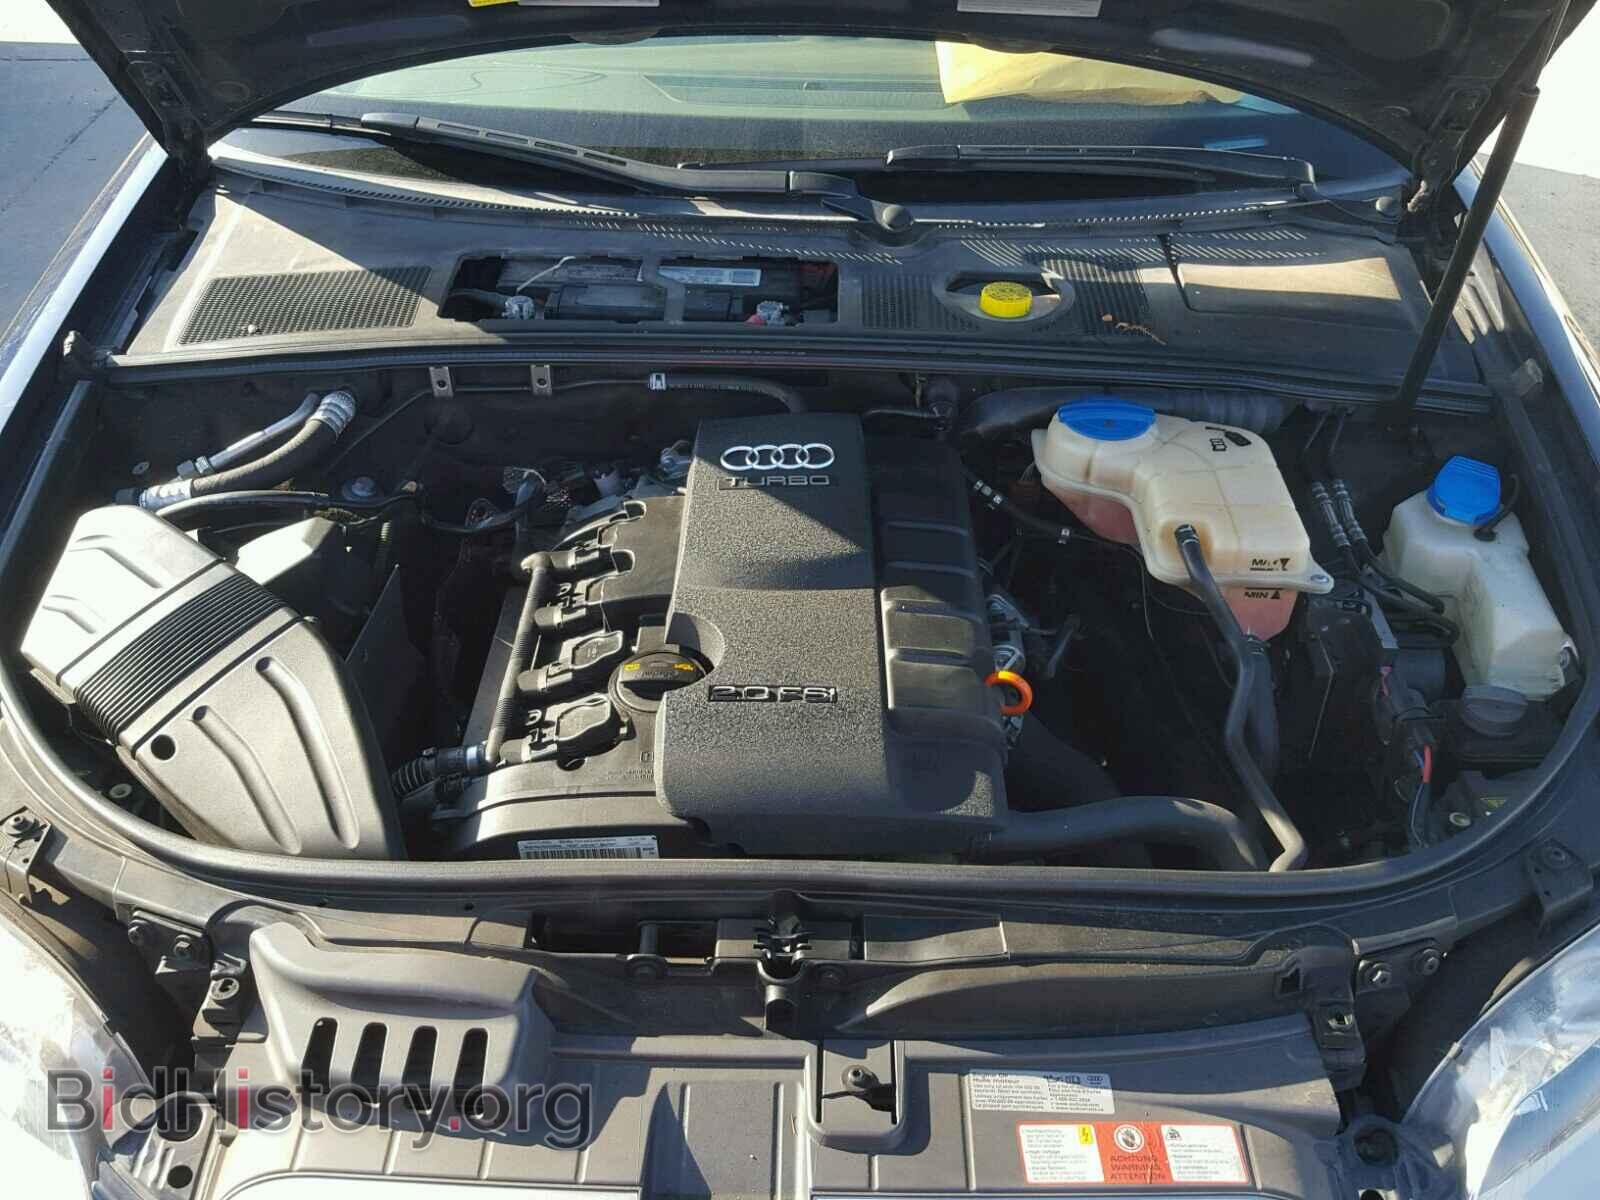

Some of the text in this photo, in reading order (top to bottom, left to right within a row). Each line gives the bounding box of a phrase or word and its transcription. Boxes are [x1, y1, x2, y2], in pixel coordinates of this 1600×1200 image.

[724, 474, 830, 487] TURBO
[1110, 1154, 1159, 1162] ACHTUNG
[1110, 1163, 1161, 1171] WARNING
[1110, 1172, 1166, 1181] ATTENTION
